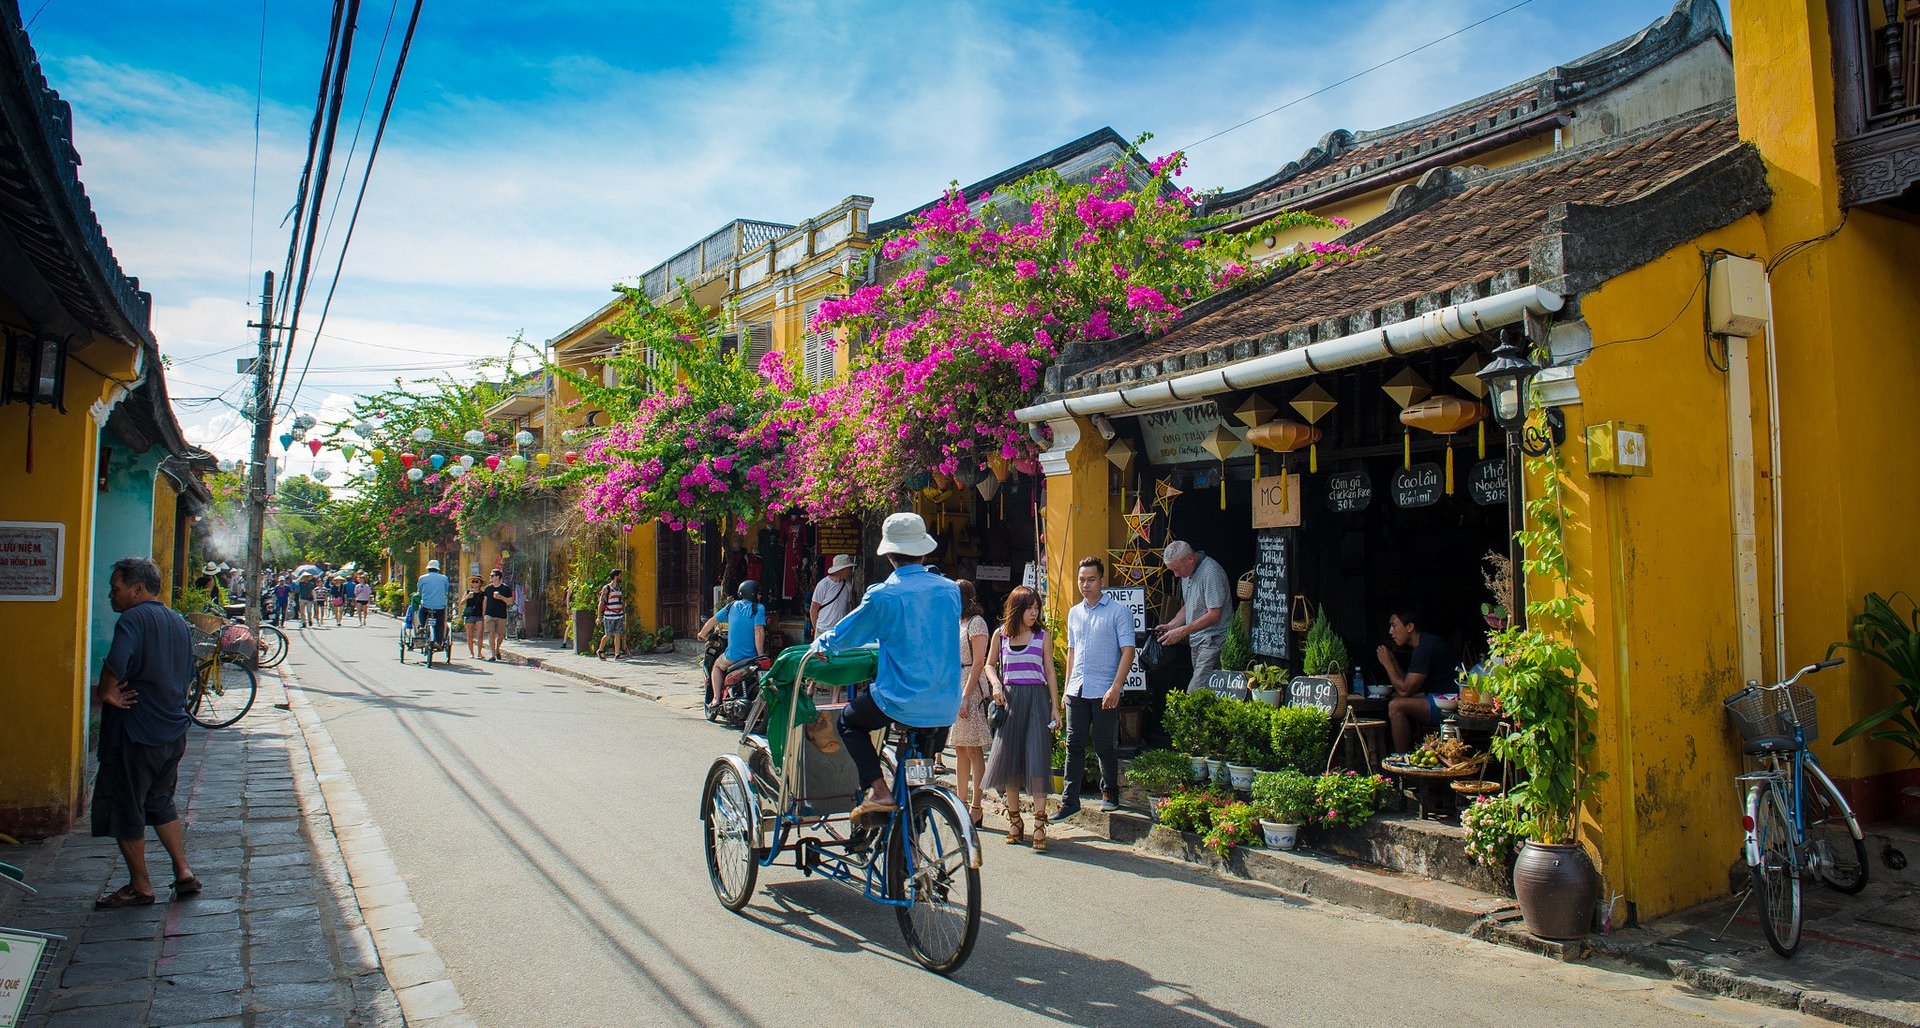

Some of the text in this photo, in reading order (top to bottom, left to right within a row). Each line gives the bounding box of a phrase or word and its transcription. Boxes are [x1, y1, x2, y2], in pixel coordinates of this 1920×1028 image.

[0, 557, 9, 567] AO
[1208, 673, 1225, 689] Cao
[1313, 681, 1332, 700] gà
